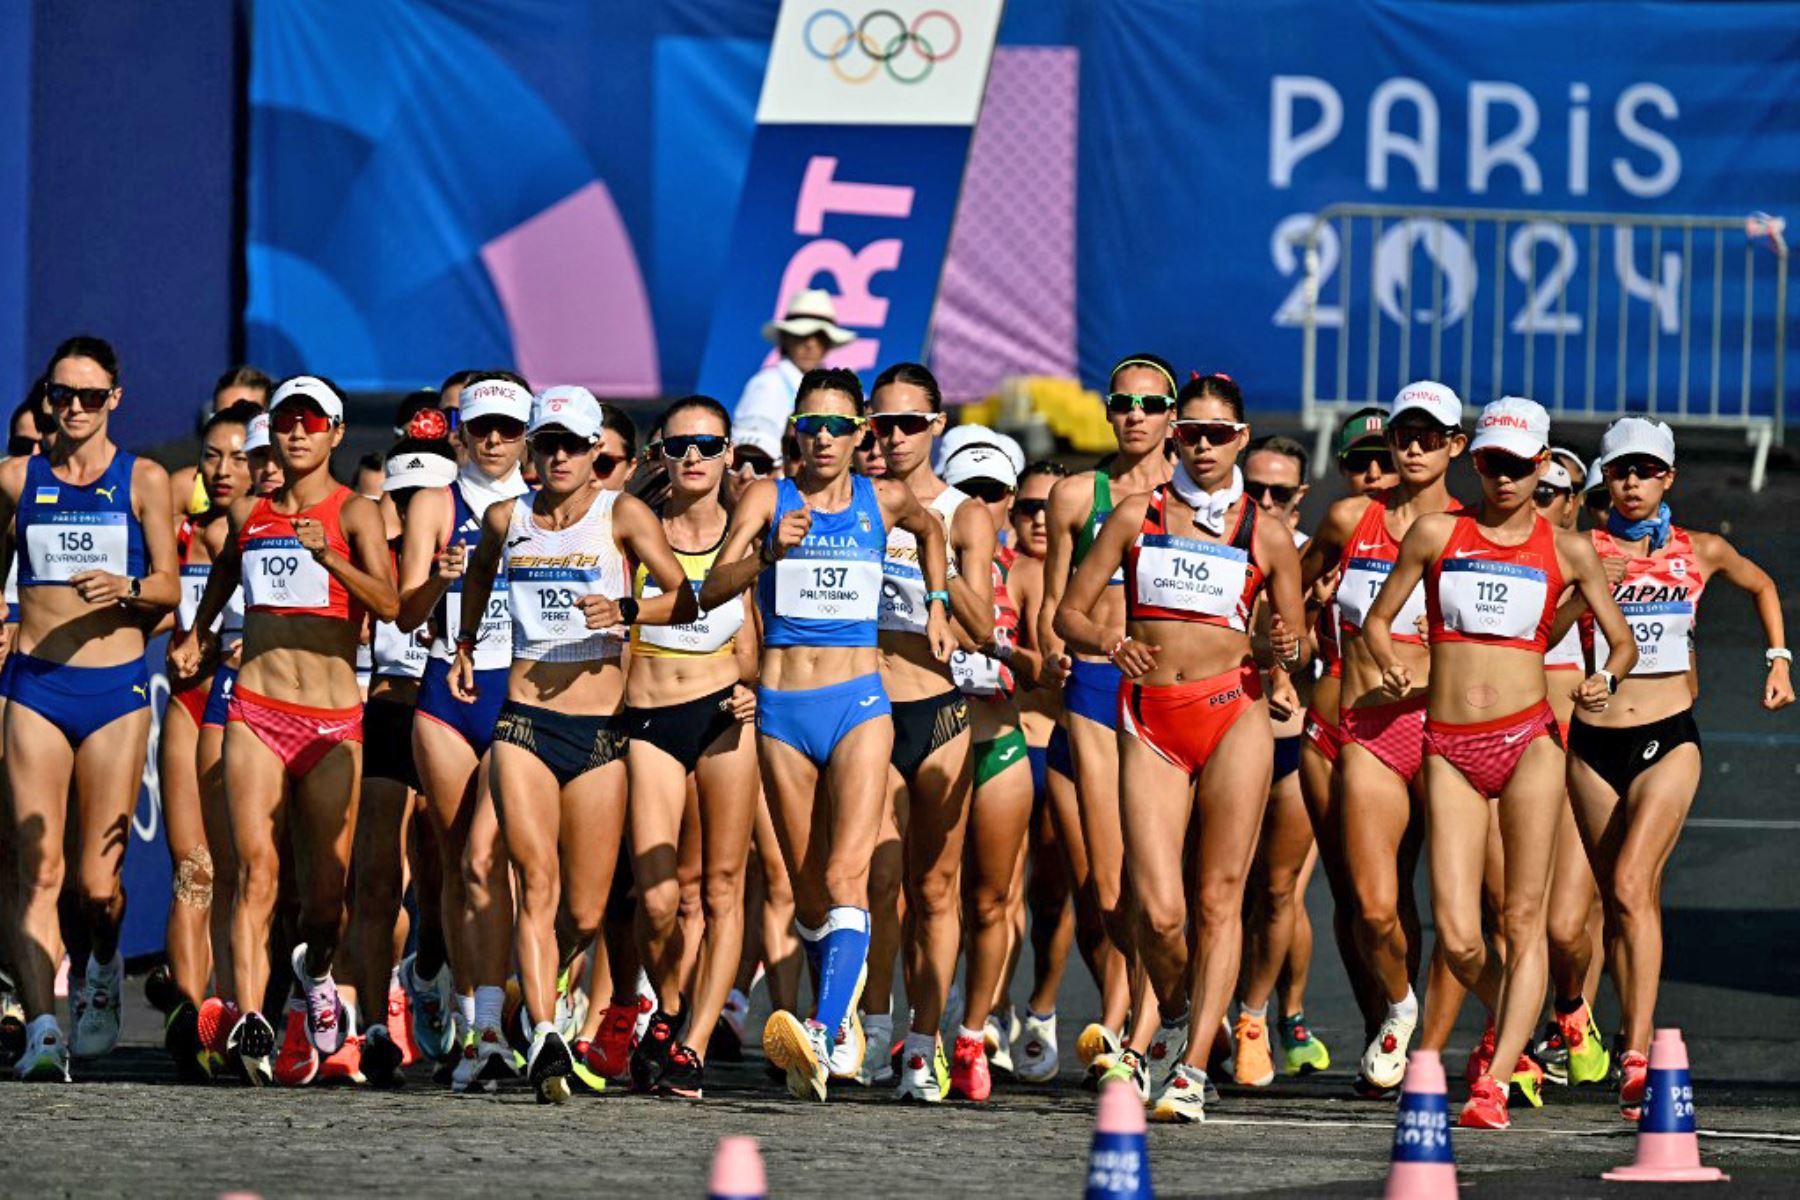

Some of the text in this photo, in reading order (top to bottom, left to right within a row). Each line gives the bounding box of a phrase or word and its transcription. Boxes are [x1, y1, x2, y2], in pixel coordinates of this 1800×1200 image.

[1271, 212, 1682, 335] 2024
[474, 385, 516, 401] FRANCE
[1403, 391, 1442, 405] CHINA
[1484, 415, 1528, 431] CHINA
[58, 532, 94, 551] 158
[801, 535, 858, 548] ITALIA
[261, 556, 298, 576] 109
[1172, 557, 1209, 581] 146
[812, 567, 848, 588] 137
[537, 588, 573, 609] 123
[1476, 581, 1508, 603] 112
[1612, 583, 1689, 602] JAPAN
[541, 611, 571, 621] PEREZ
